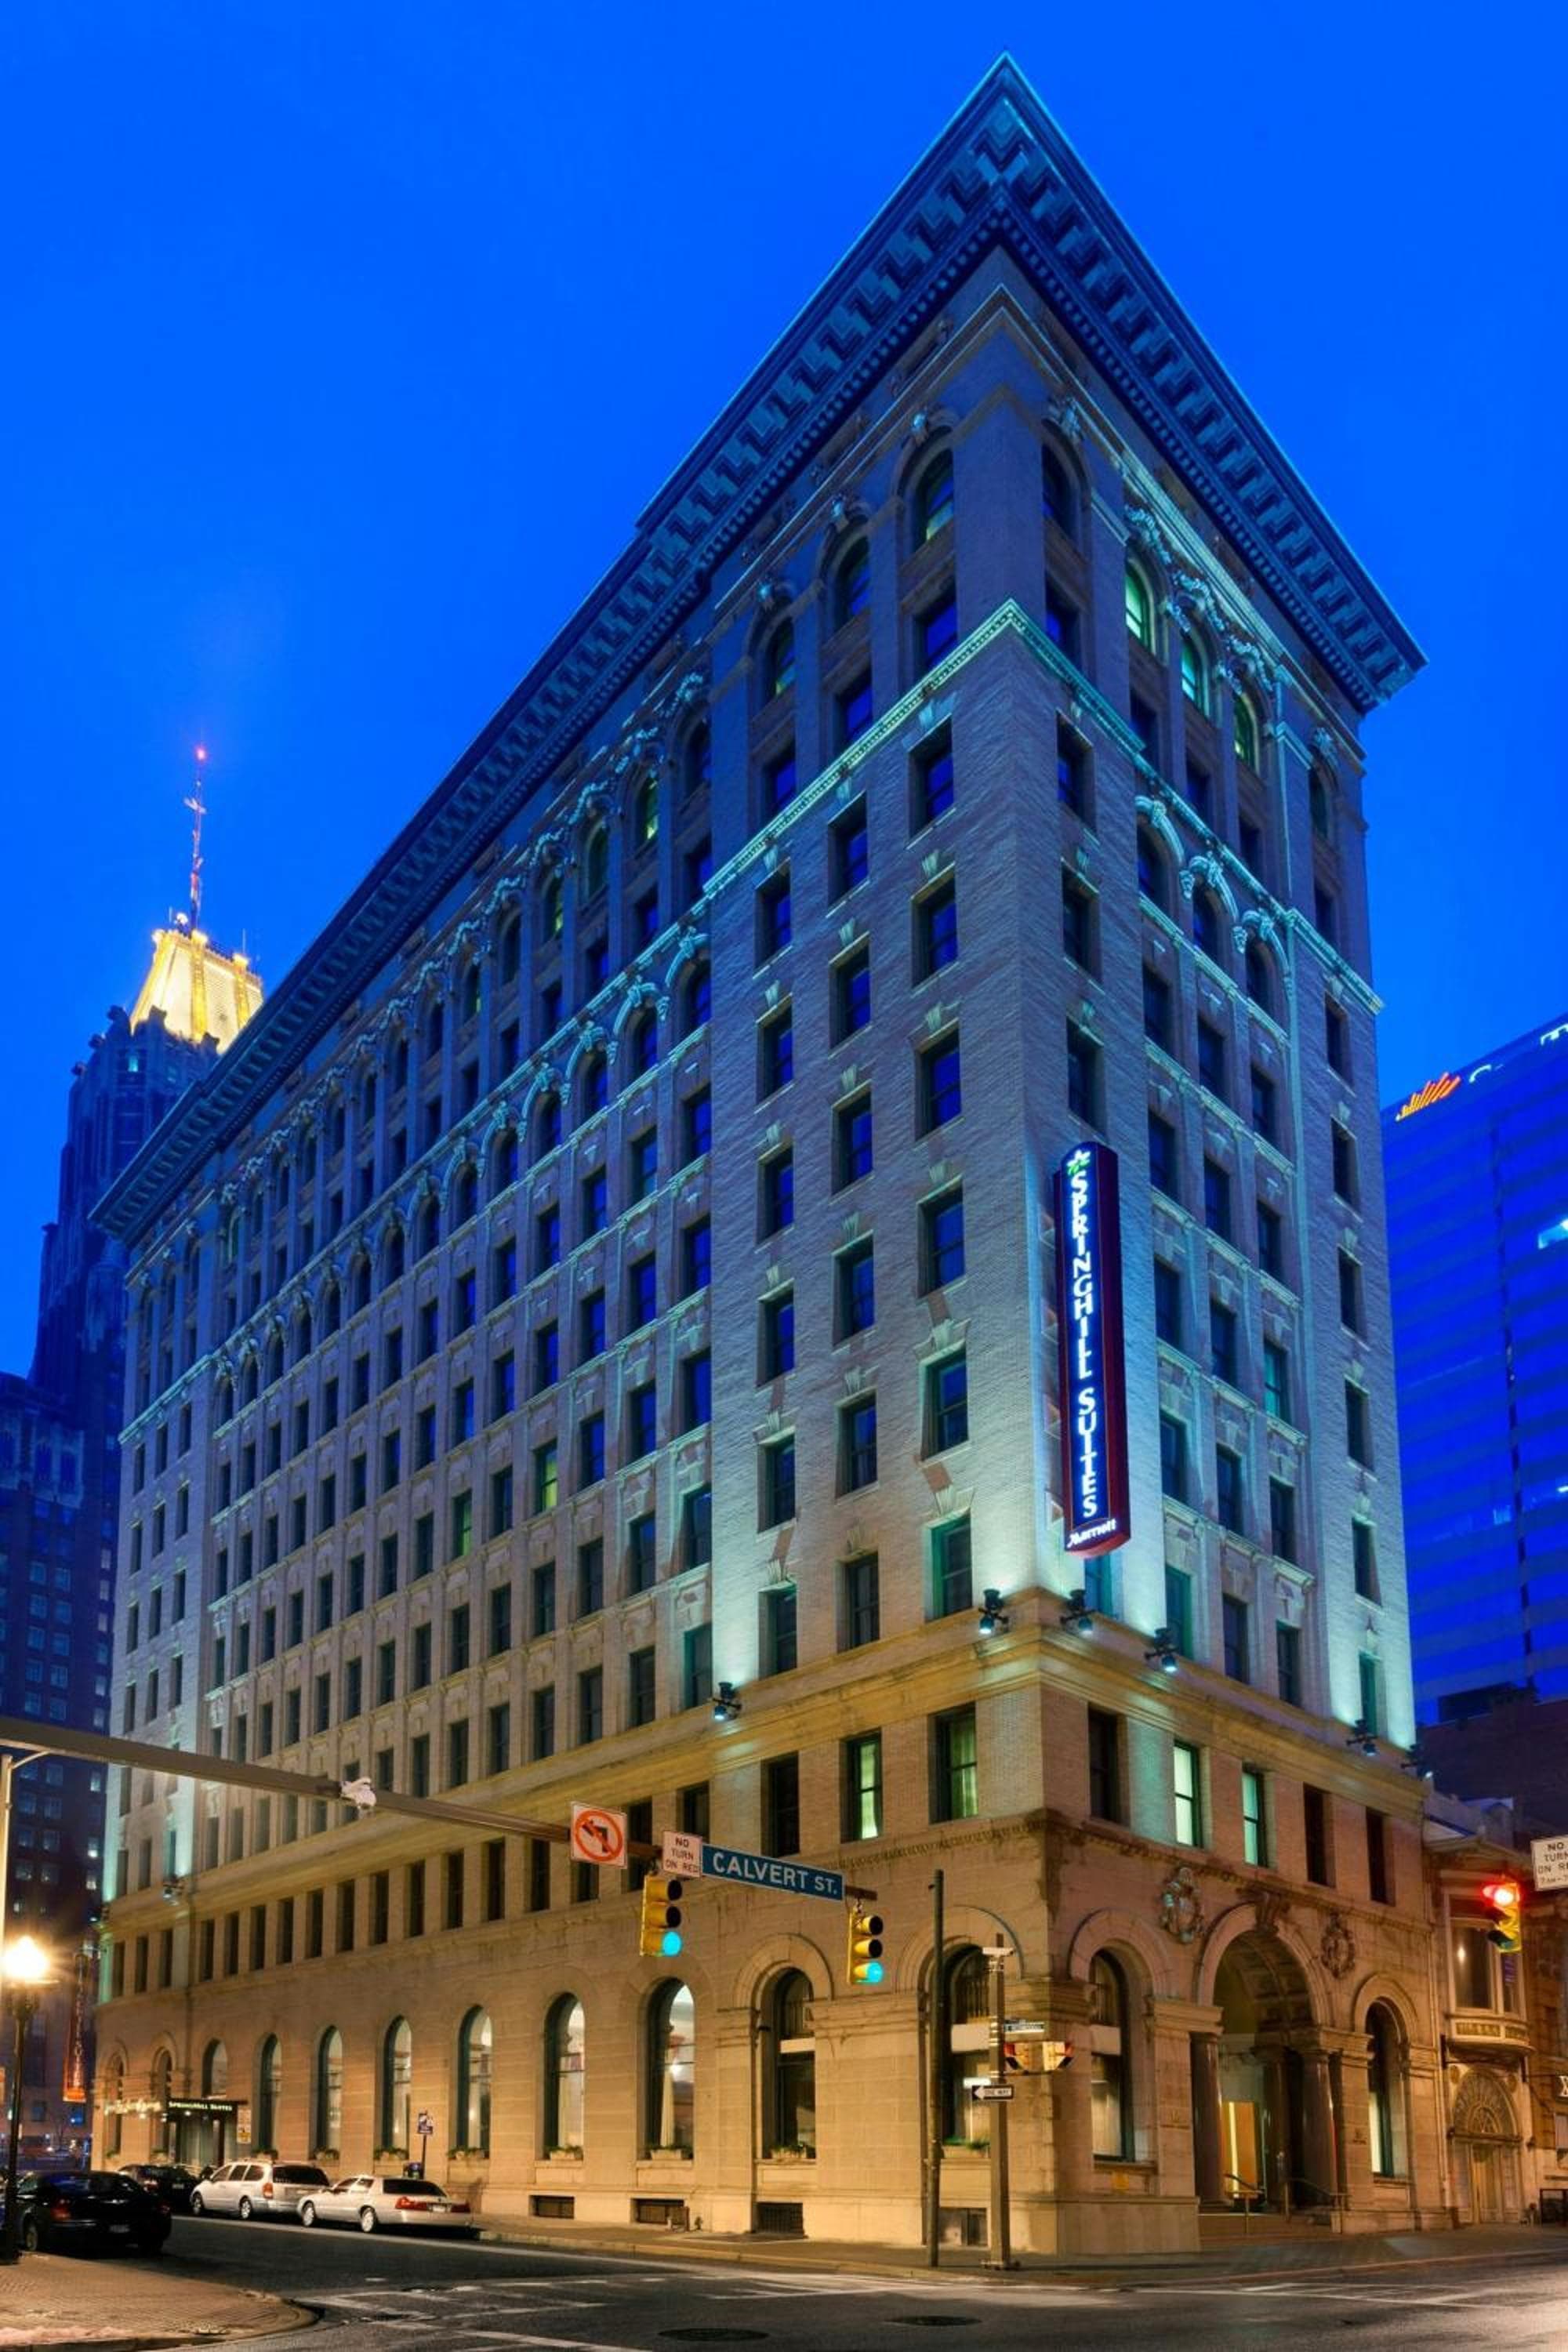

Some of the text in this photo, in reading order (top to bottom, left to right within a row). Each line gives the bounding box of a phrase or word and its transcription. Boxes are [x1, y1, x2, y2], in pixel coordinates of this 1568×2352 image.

[1070, 1170, 1098, 1519] SPRINGHILL SUITES
[675, 1836, 689, 1848] NO
[1547, 1842, 1565, 1851] NO
[671, 1847, 694, 1861] TURN
[665, 1859, 699, 1873] ON RED
[1537, 1865, 1552, 1875] ON
[713, 1853, 837, 1894] CALVERT ST.
